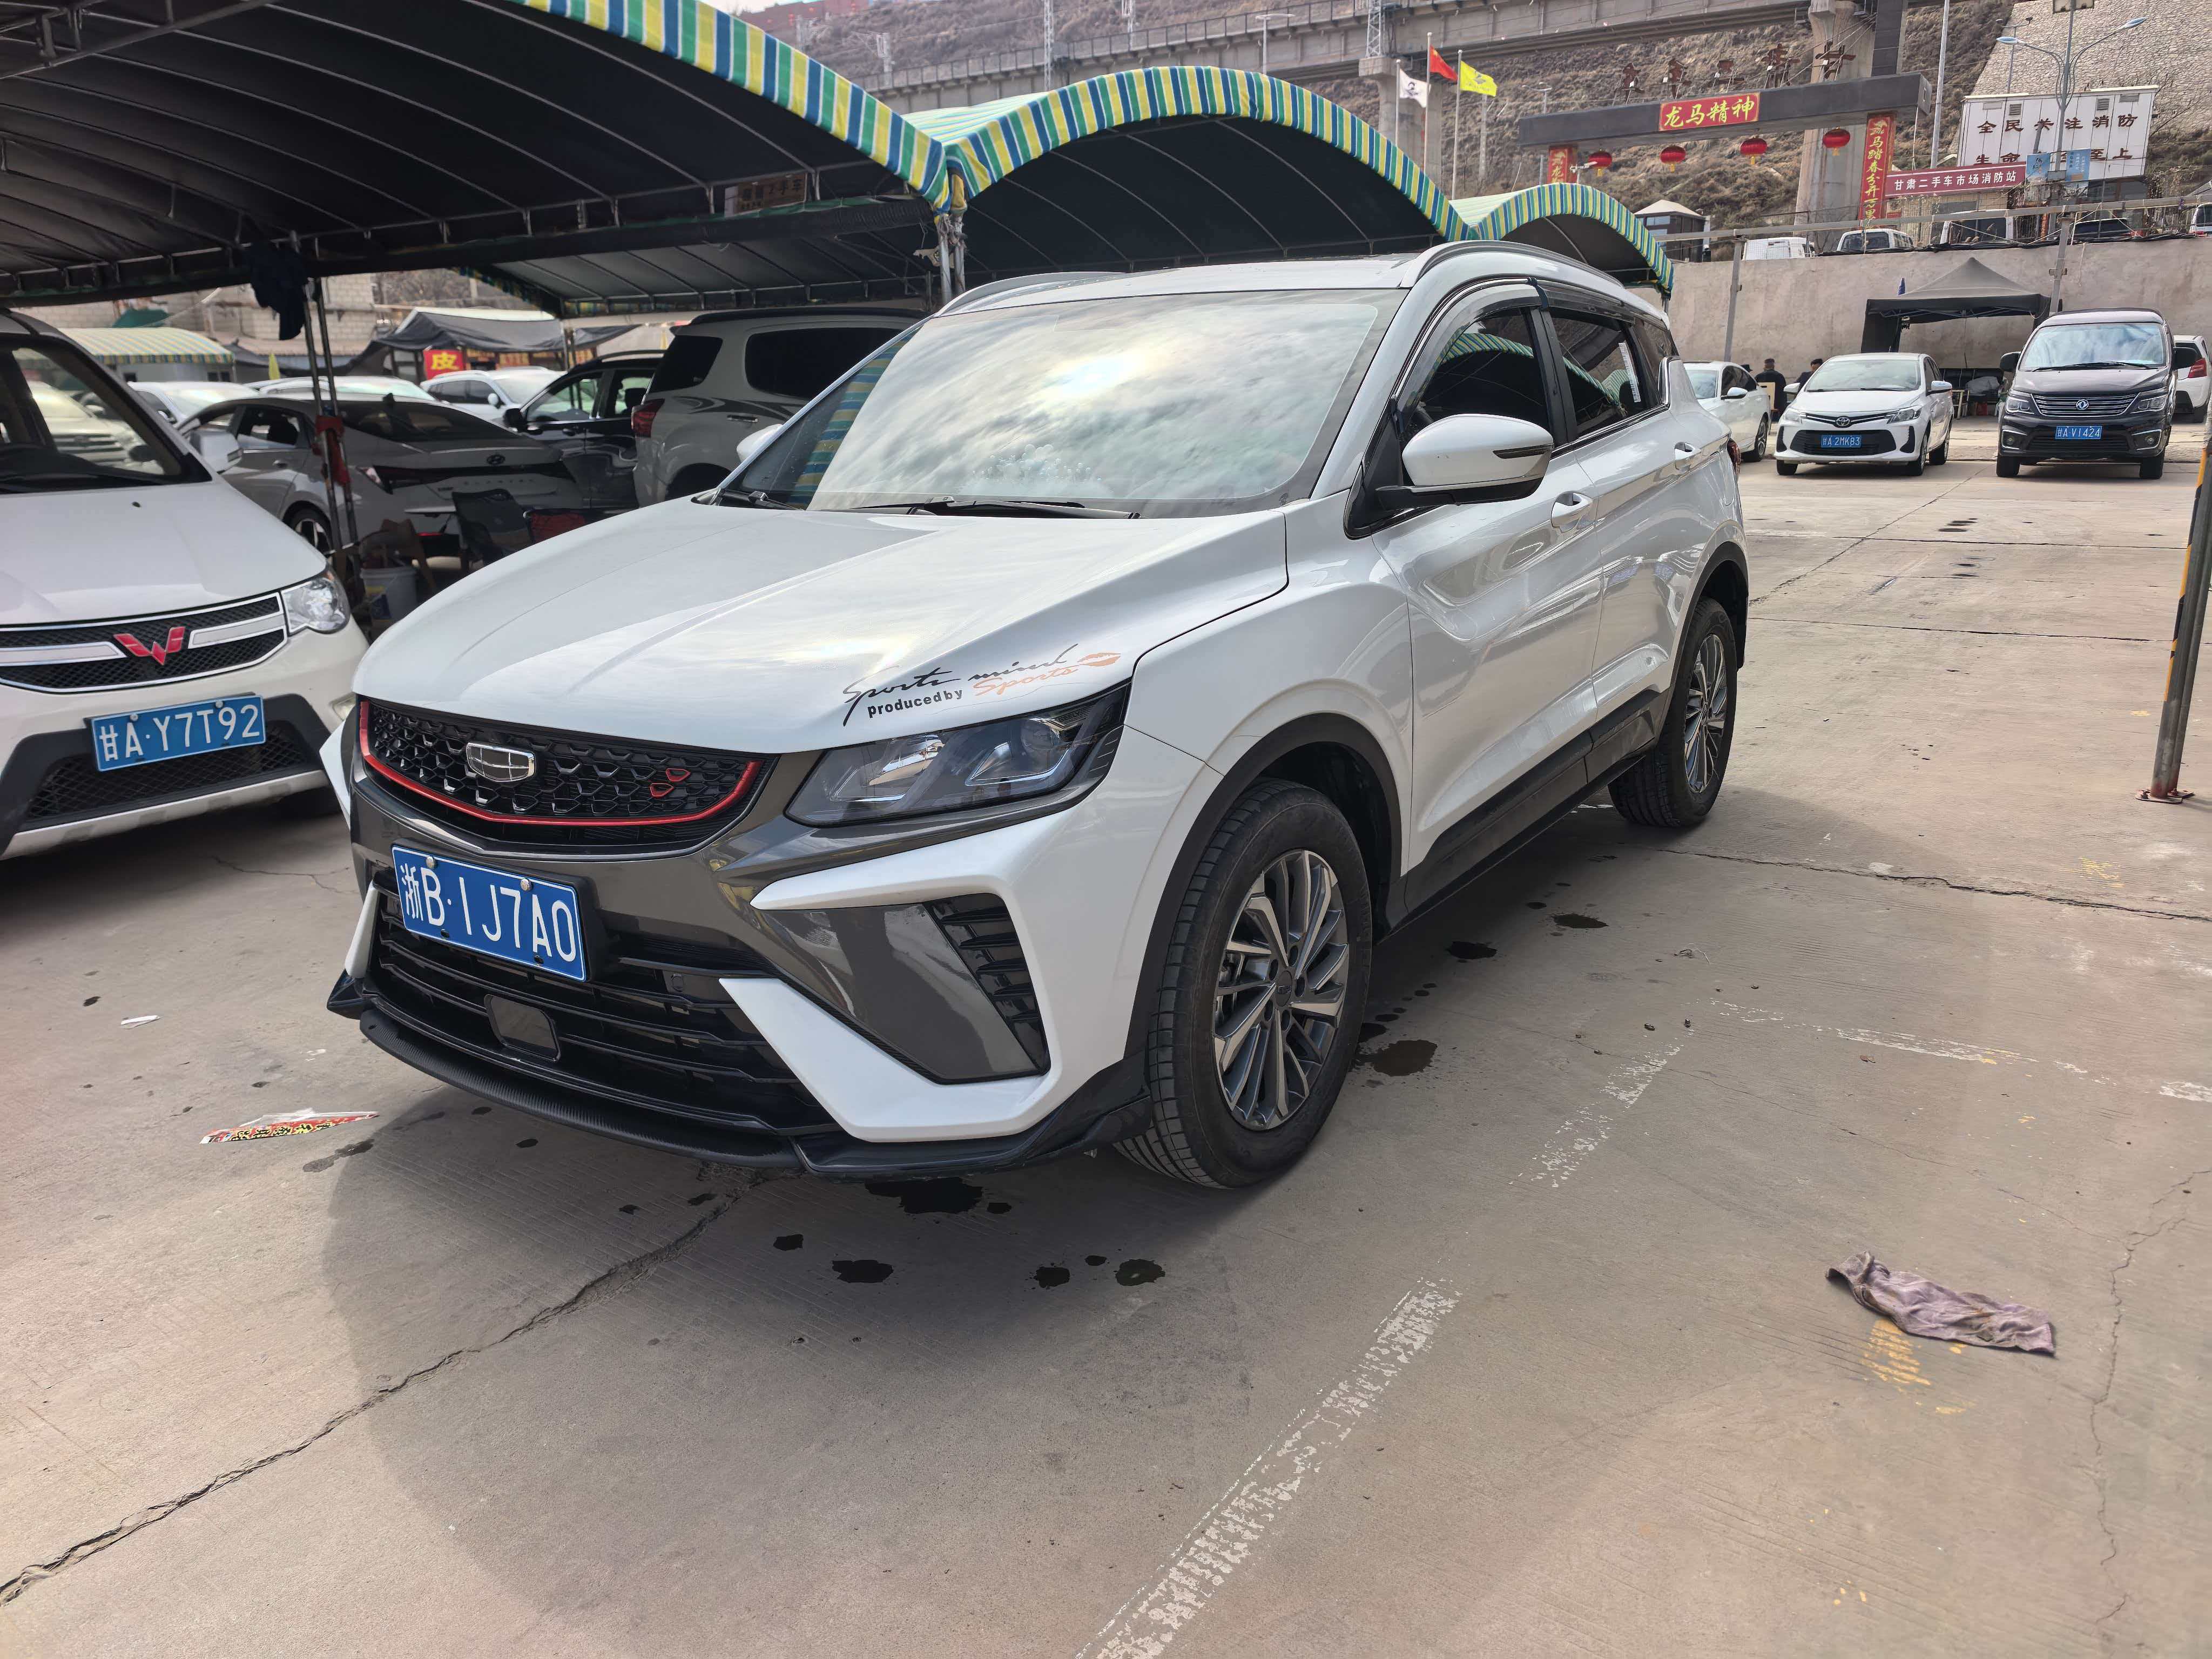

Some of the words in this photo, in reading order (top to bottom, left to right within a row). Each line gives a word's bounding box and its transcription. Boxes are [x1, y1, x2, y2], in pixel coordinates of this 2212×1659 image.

[1664, 95, 1755, 128] 龙马精神
[1977, 113, 2139, 134] 全民关注消防
[1894, 170, 2017, 191] 甘肃二手车市场消防站
